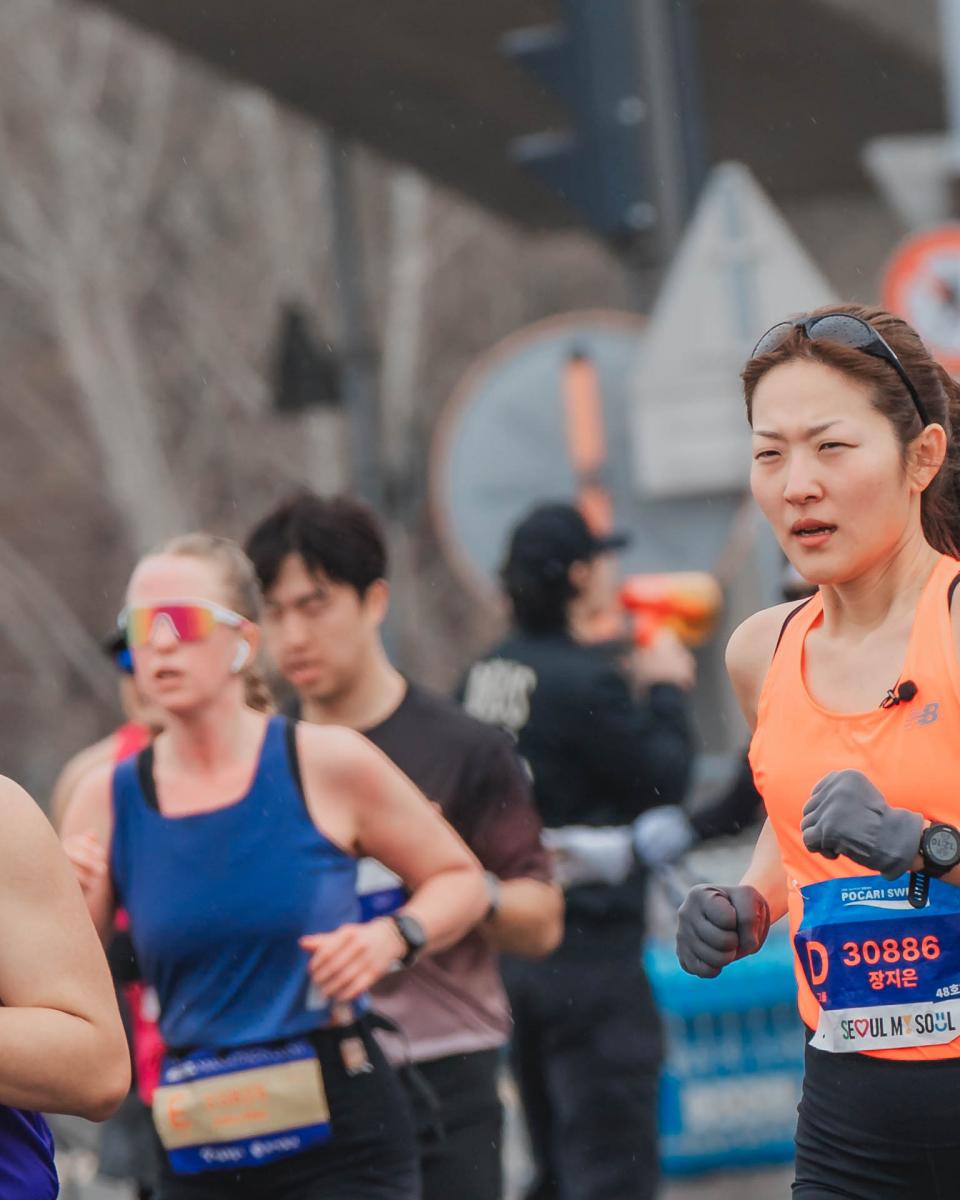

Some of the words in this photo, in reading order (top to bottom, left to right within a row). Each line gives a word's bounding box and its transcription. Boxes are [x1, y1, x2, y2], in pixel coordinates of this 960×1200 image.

[841, 888, 885, 902] POCARI
[842, 934, 941, 967] 30886
[805, 941, 829, 986] D
[868, 968, 919, 990] 장지은
[914, 1010, 956, 1035] SOUL
